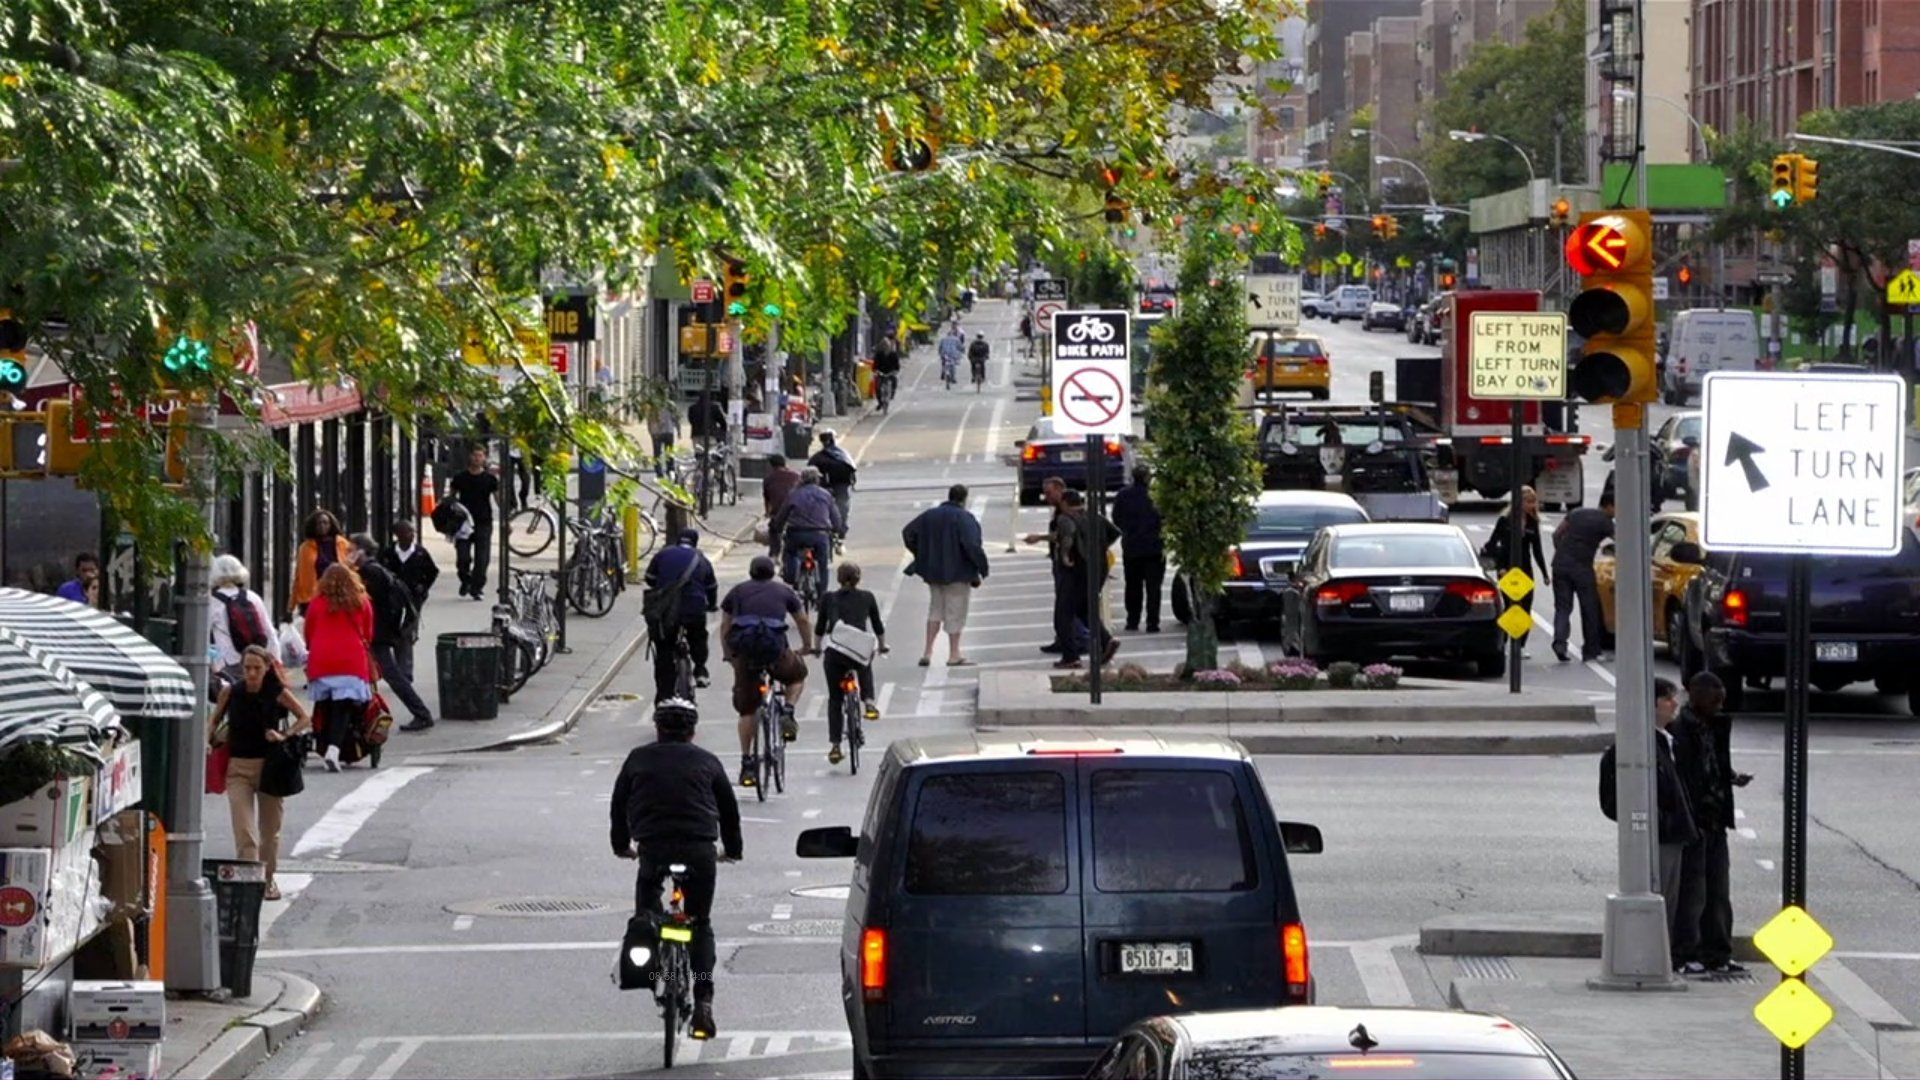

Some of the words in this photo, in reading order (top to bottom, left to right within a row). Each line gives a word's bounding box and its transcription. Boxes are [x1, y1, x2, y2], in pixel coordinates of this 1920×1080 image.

[1268, 282, 1294, 292] LEFT
[1267, 296, 1296, 306] TURN
[1266, 310, 1295, 320] LANE
[1476, 323, 1512, 336] LEFT
[1521, 323, 1560, 337] TURN
[1058, 344, 1088, 357] BIKE
[1091, 344, 1125, 357] PATH
[1495, 340, 1541, 354] FROM
[1476, 358, 1512, 371] LEFT
[1520, 358, 1560, 371] TURN
[1476, 375, 1507, 387] BAY
[1515, 375, 1558, 387] ONY
[1793, 402, 1879, 432] LEFT
[1790, 449, 1884, 480] TURN
[1788, 497, 1880, 527] LANE
[922, 1015, 977, 1025] ASTRO
